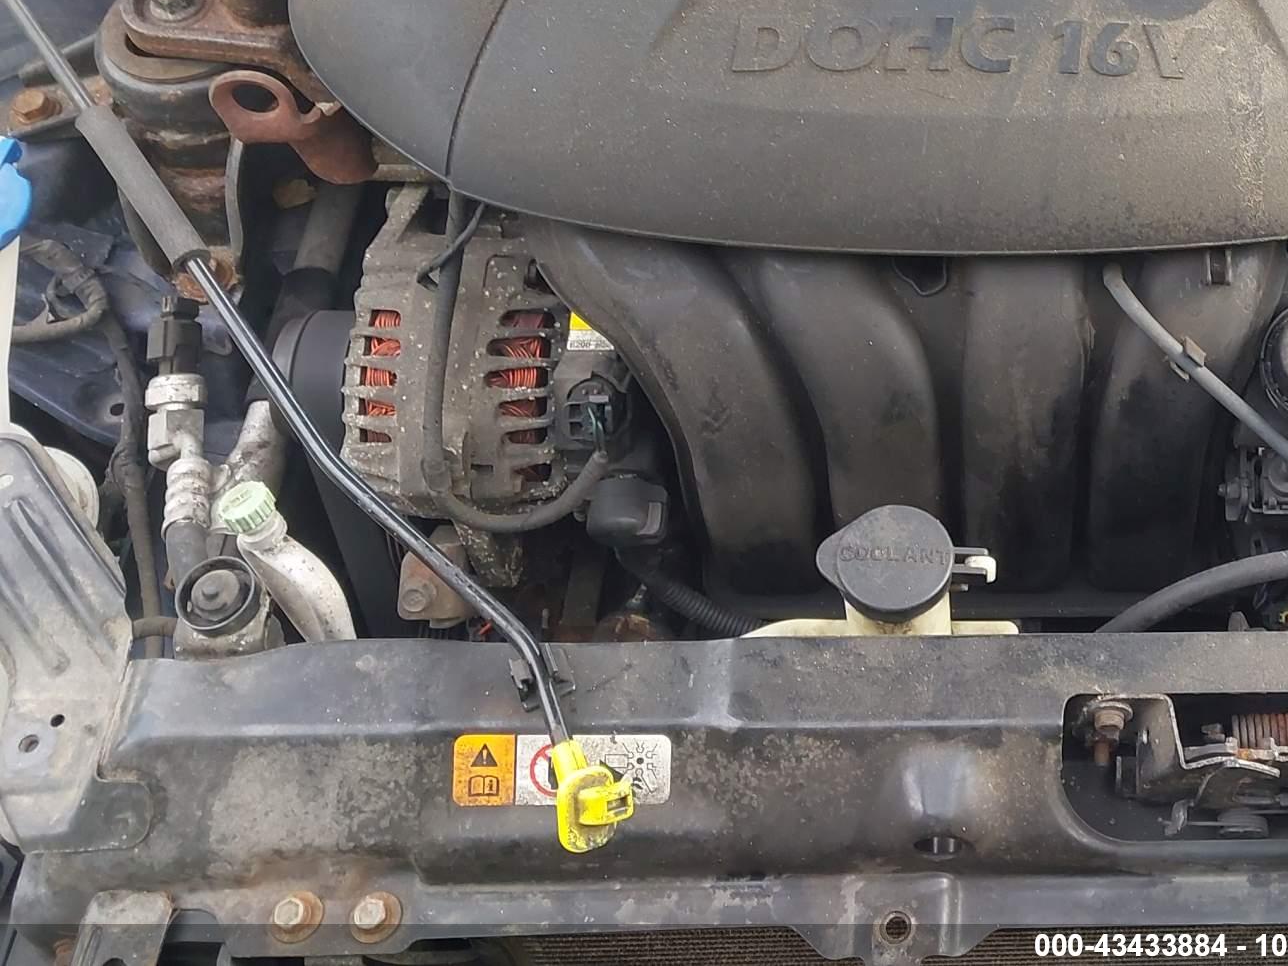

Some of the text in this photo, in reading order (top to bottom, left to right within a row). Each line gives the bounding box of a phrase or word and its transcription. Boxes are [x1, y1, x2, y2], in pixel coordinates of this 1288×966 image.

[731, 16, 1207, 79] DOHC 16V
[839, 544, 950, 566] COOLANT
